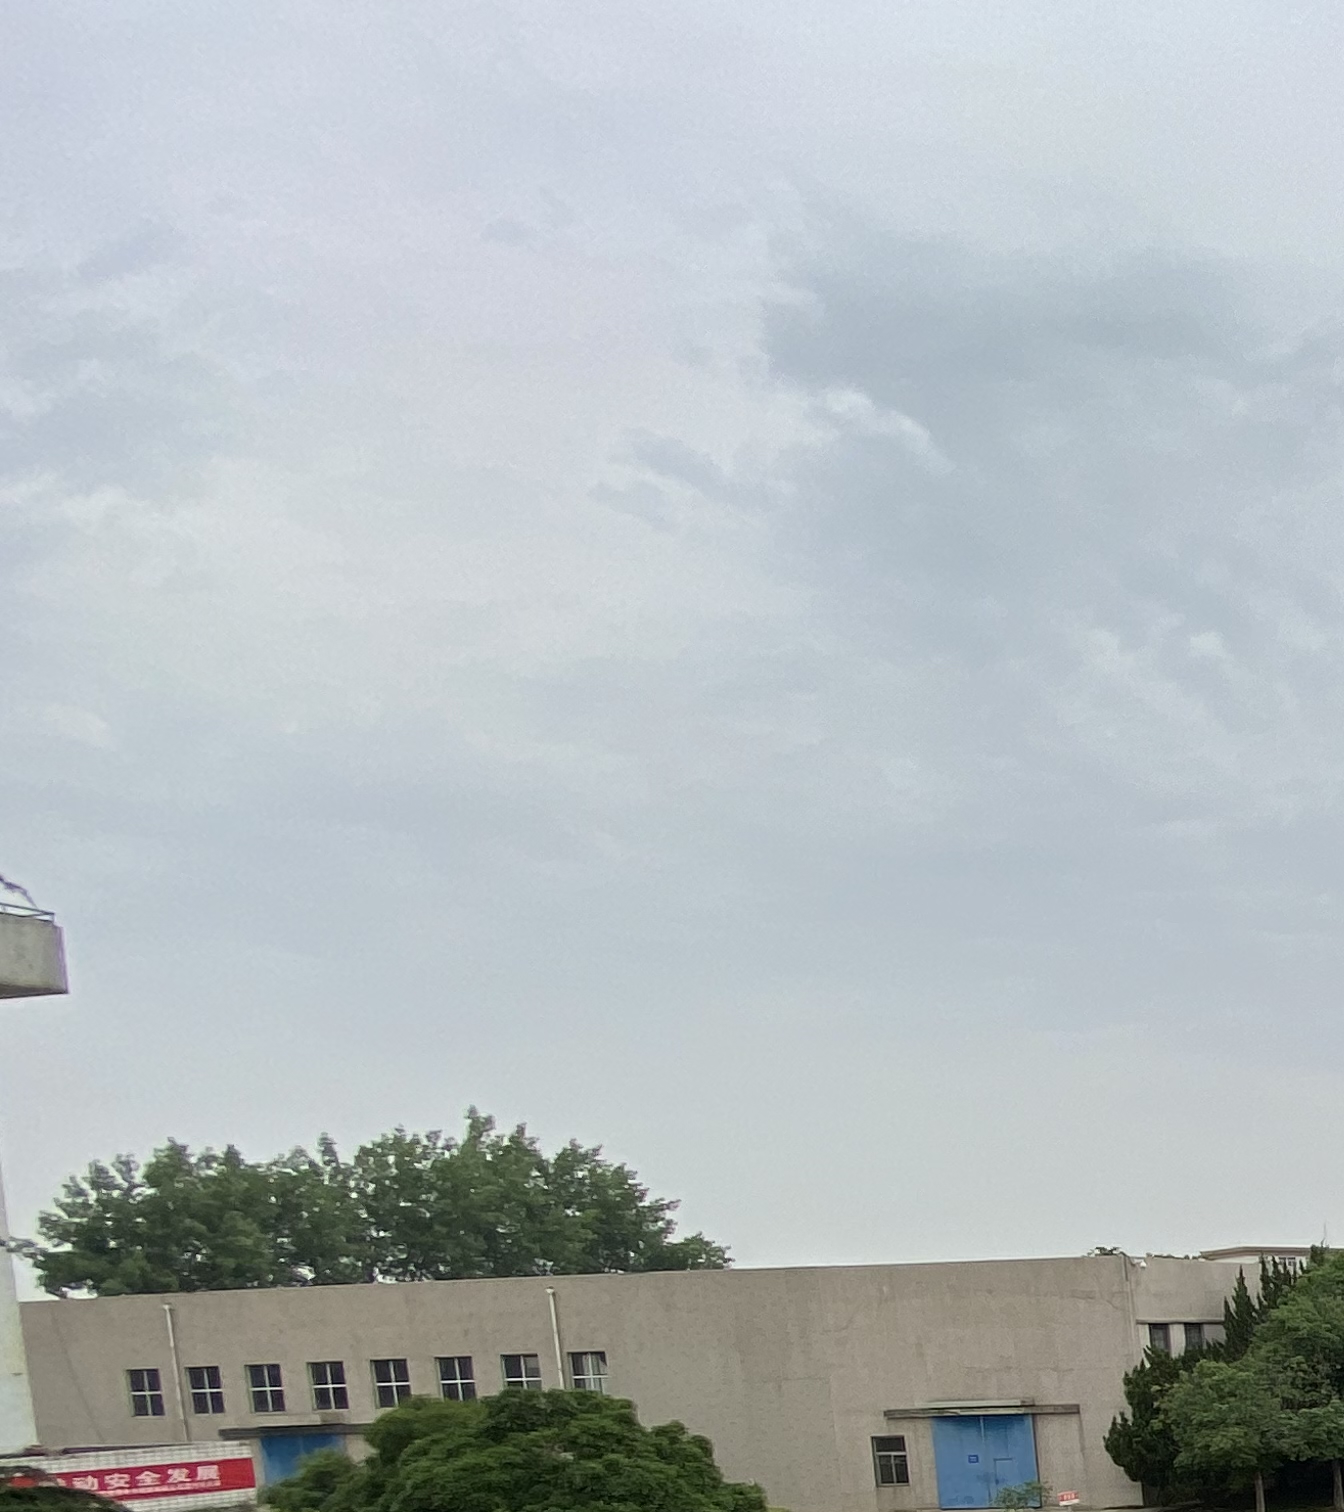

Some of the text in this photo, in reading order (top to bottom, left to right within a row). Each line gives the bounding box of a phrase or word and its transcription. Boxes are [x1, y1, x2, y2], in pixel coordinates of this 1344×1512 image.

[56, 1464, 221, 1491] 动安全发展
